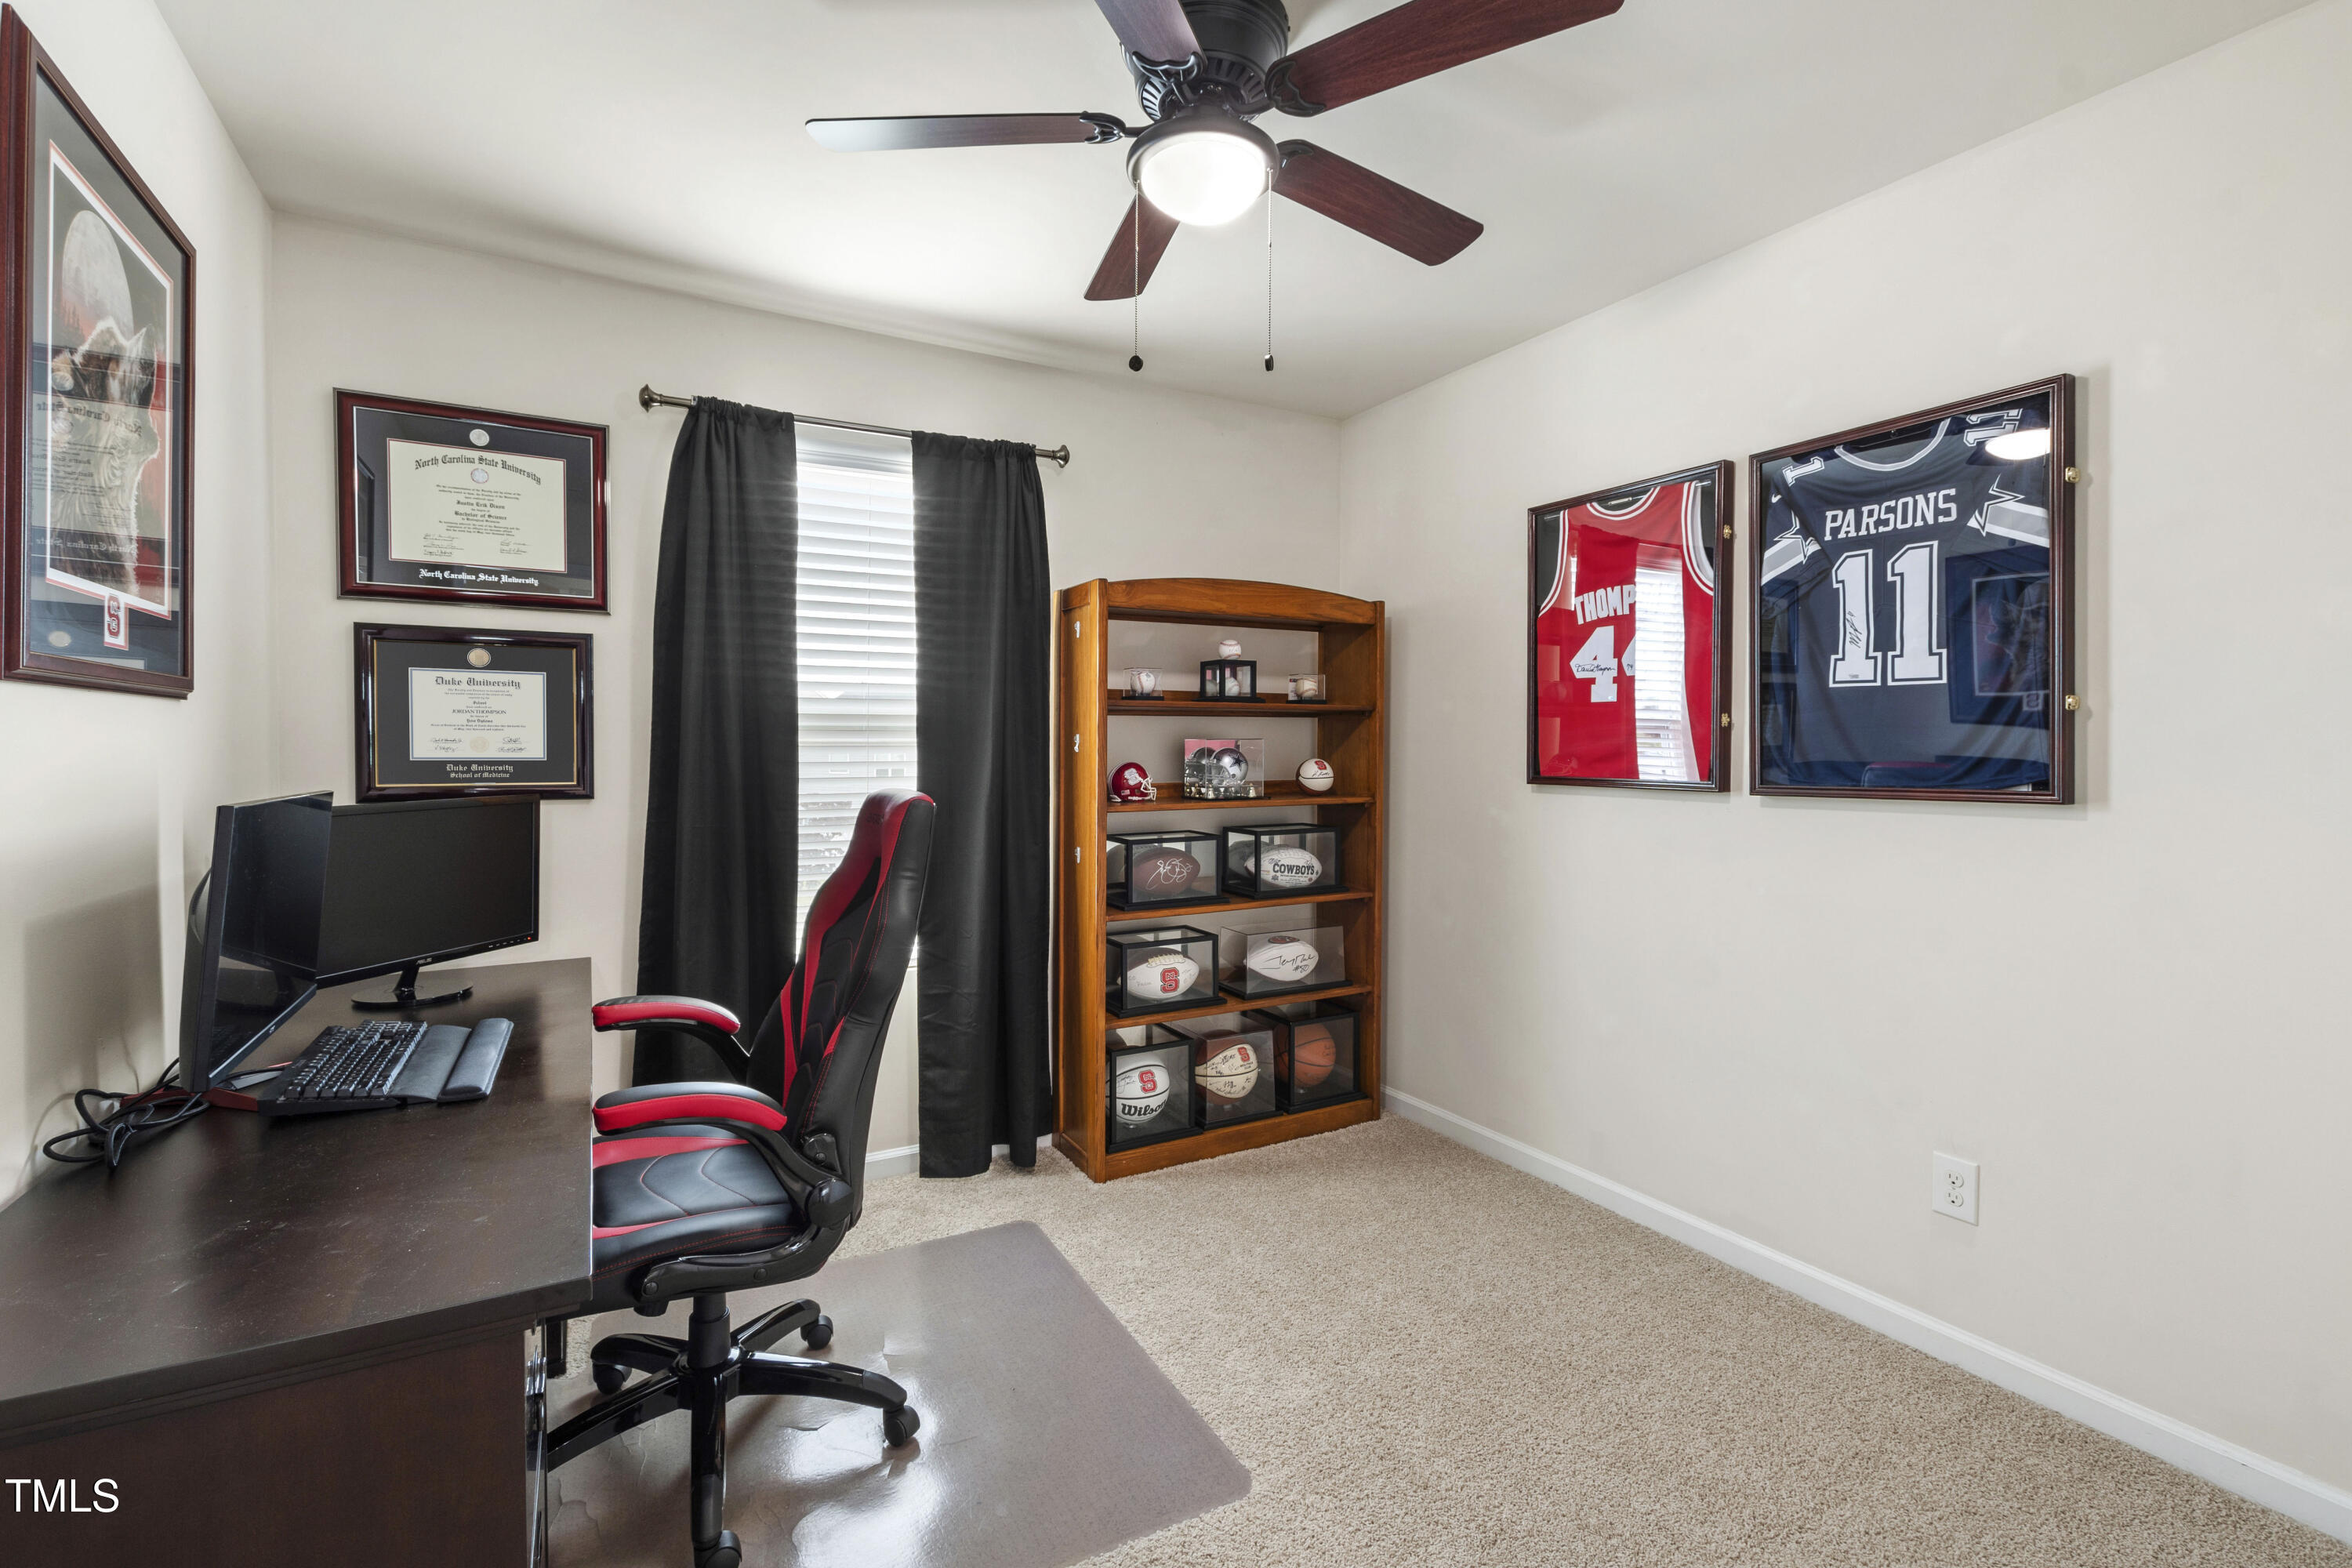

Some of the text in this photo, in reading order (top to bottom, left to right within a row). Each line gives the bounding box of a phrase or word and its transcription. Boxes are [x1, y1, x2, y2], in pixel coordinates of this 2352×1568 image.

[414, 454, 541, 485] North Carolina State University
[1824, 488, 1958, 541] PARSONS
[419, 568, 539, 586] North Carolina State University
[1574, 584, 1636, 625] THOMP
[1829, 540, 1947, 687] 11
[435, 676, 521, 689] Duke University
[470, 764, 514, 772] University
[1272, 862, 1315, 876] COWBOYS
[1121, 1098, 1167, 1117] Wilson
